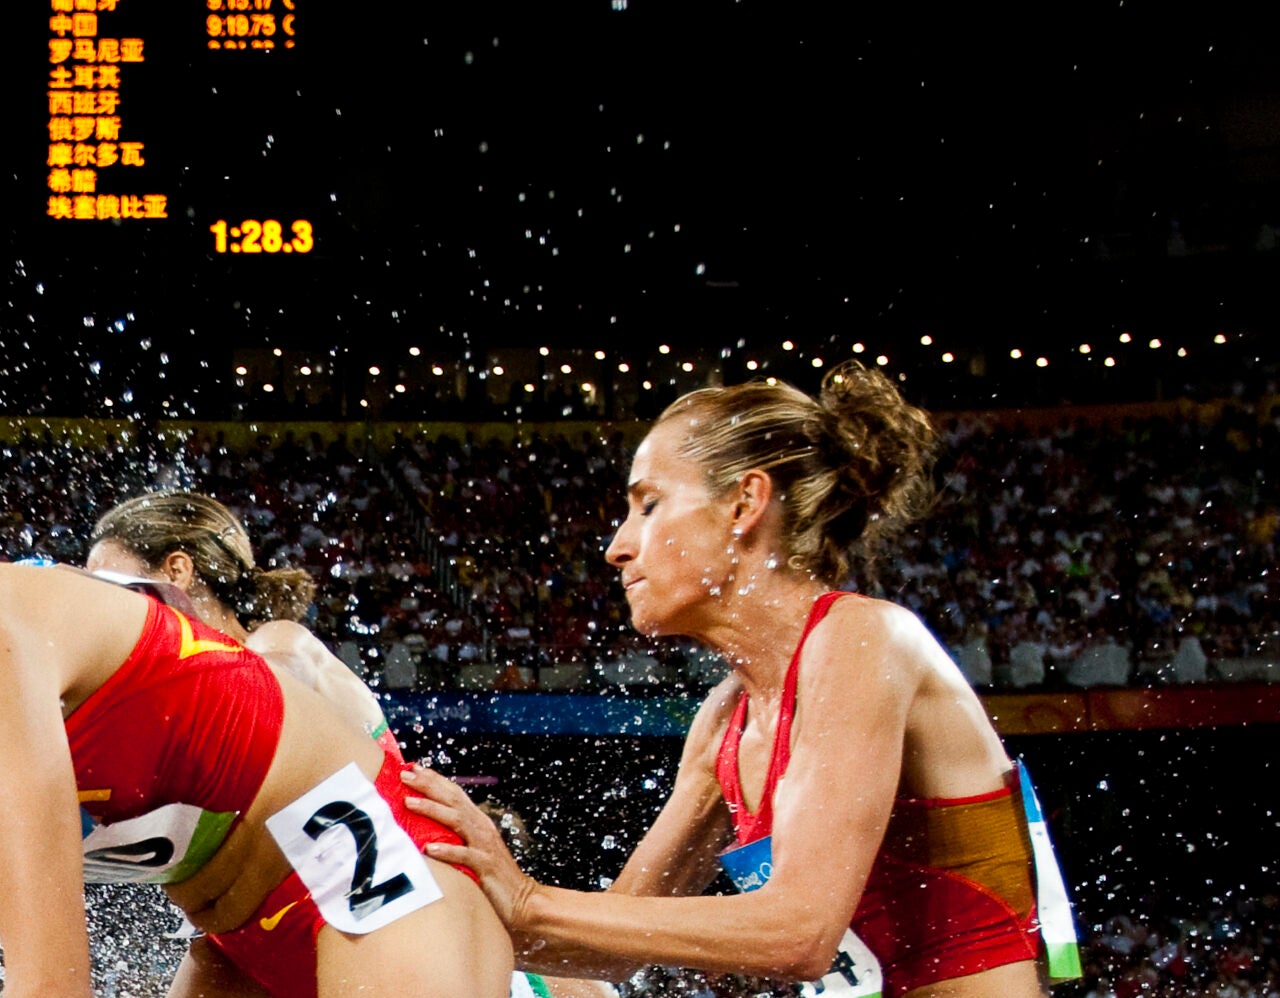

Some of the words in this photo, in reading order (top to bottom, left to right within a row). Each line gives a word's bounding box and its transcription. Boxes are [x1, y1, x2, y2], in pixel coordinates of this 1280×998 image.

[49, 12, 98, 37] 中国
[48, 38, 145, 63] 罗马尼亚
[48, 65, 121, 89] 土耳其
[47, 90, 121, 115] 西班牙
[47, 115, 121, 141] 俄罗斯
[47, 141, 145, 167] 摩尔多瓦
[47, 167, 97, 193] 希腊
[47, 194, 168, 220] 埃塞俄比亚
[210, 219, 313, 253] 1:28.3
[302, 800, 415, 921] 2
